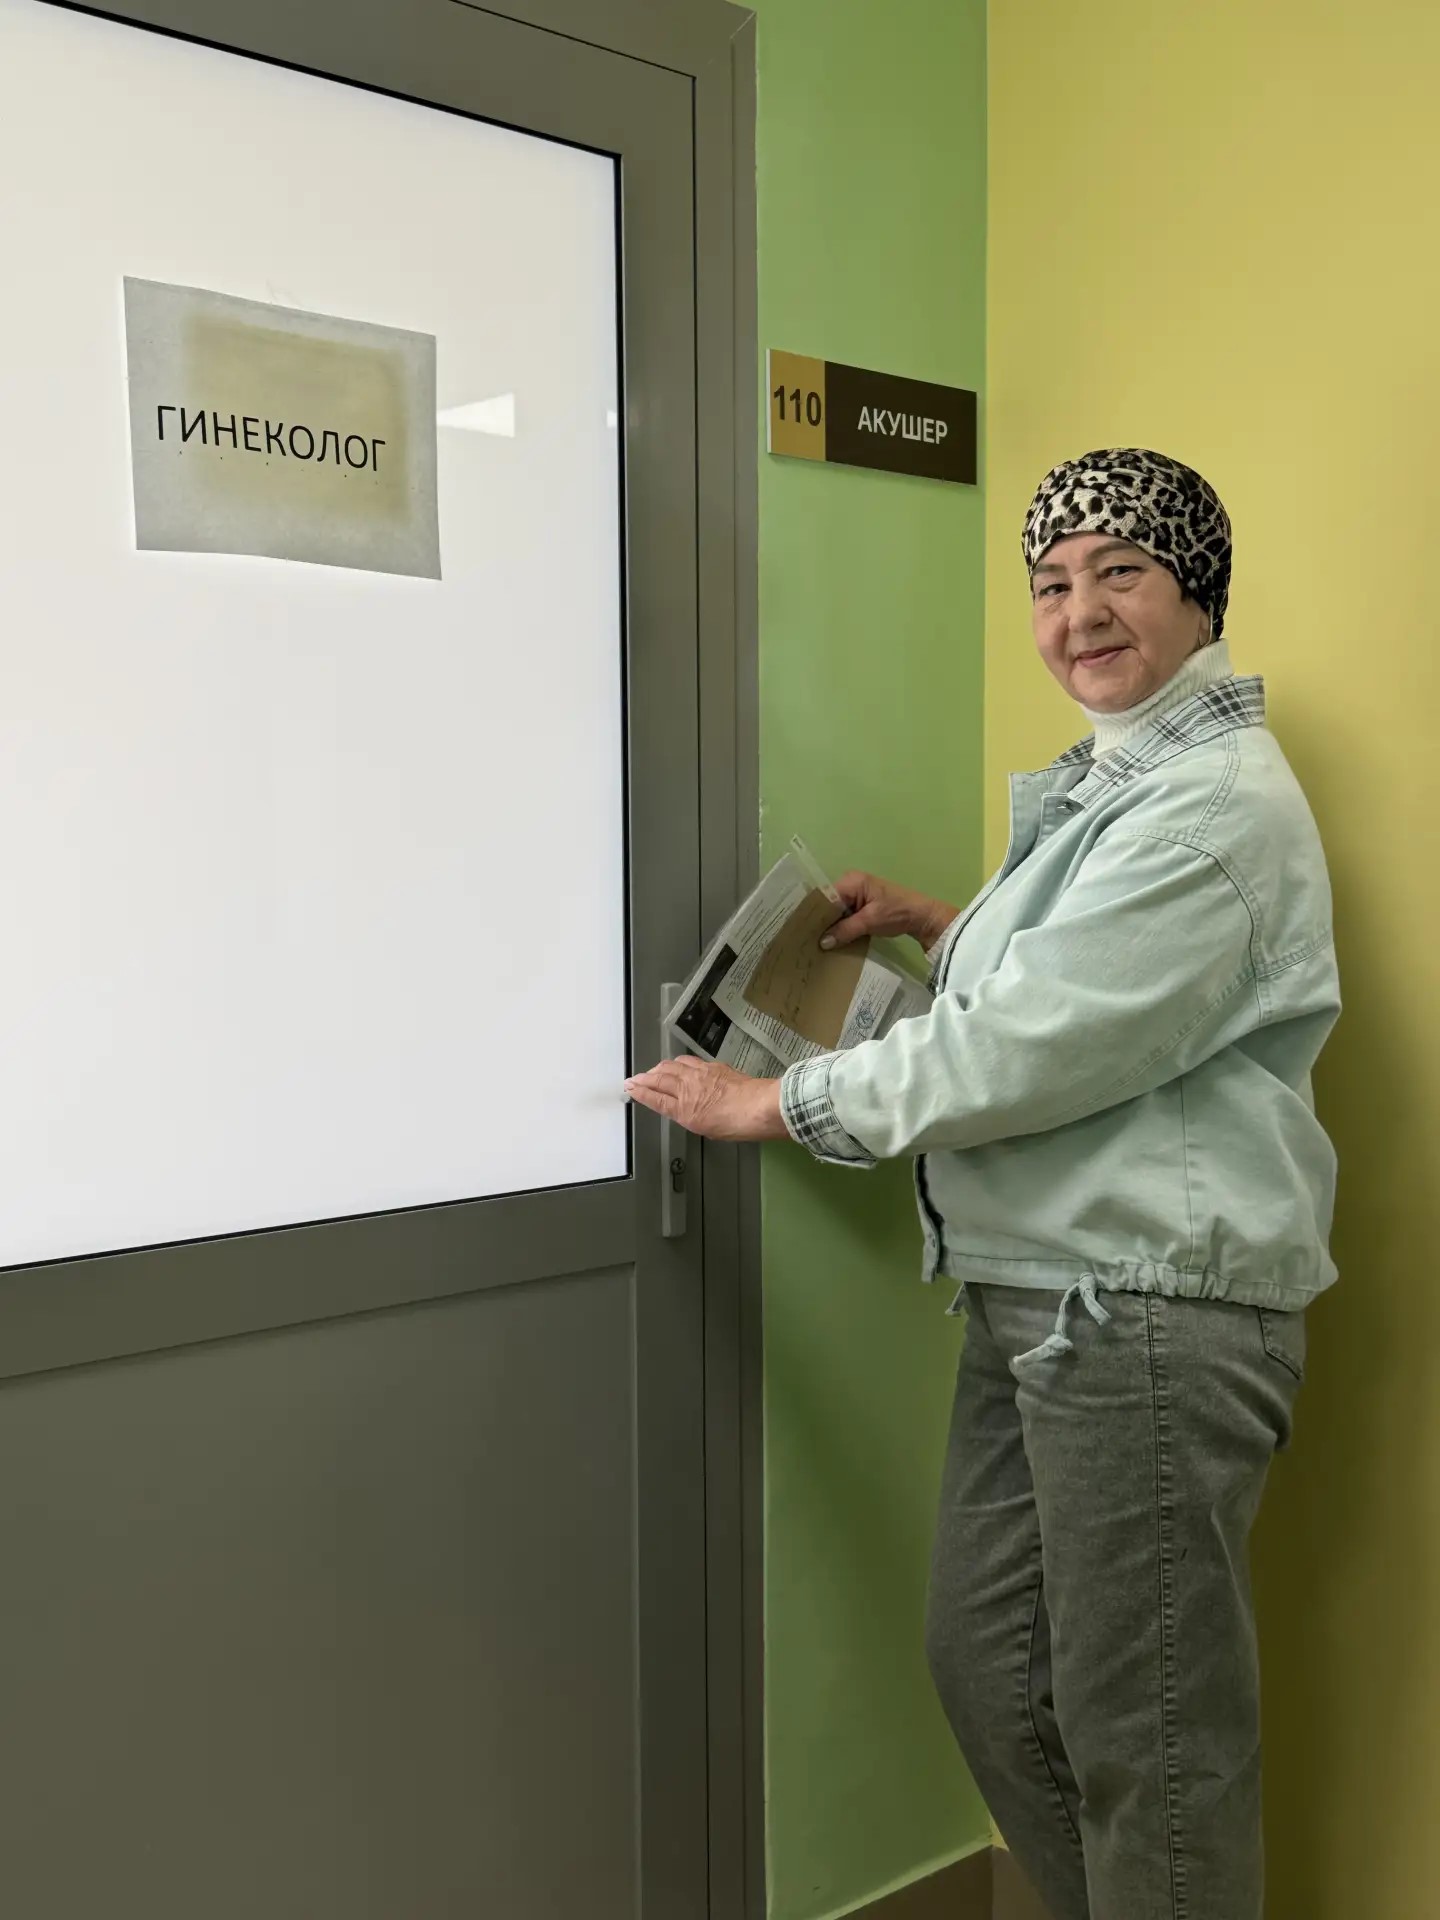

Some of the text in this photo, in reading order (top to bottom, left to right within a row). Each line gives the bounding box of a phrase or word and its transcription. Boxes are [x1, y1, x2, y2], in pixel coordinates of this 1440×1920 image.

[157, 405, 386, 471] ГИНЕКОЛОГ
[773, 385, 948, 444] 110 АКУШЕР
